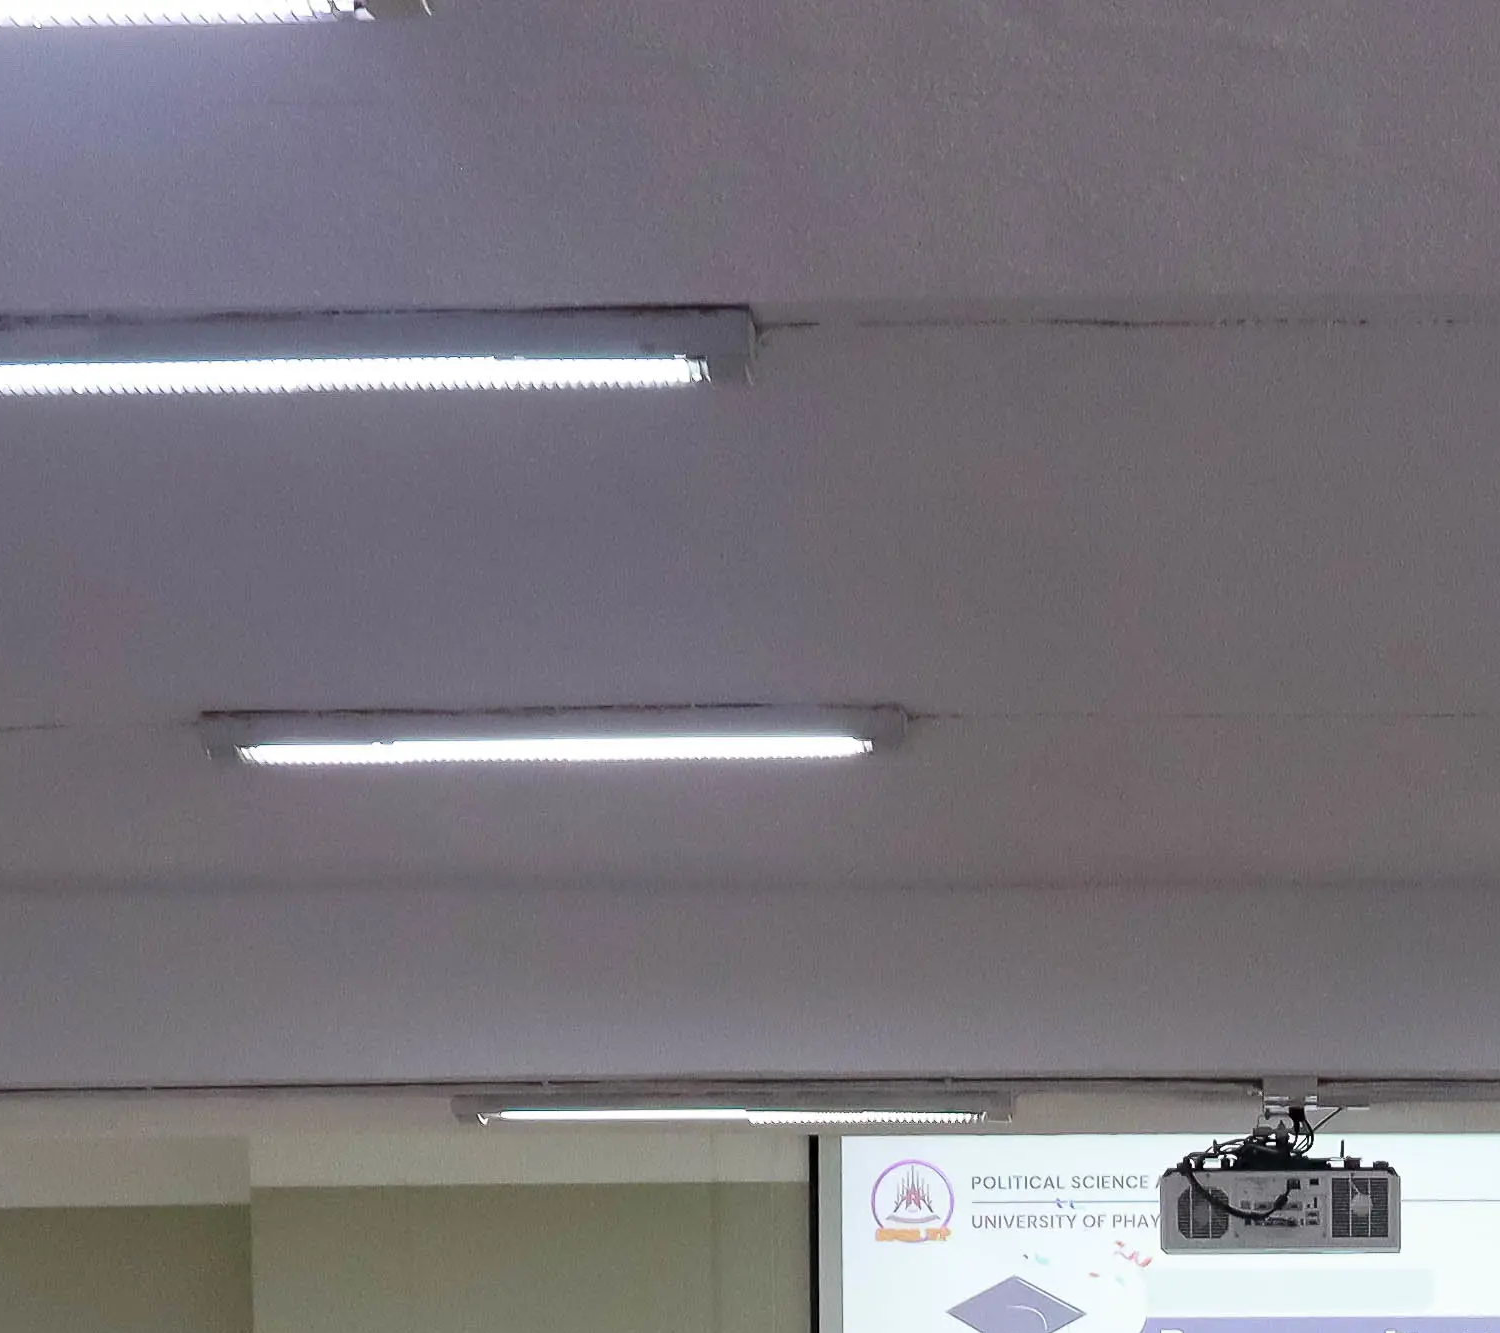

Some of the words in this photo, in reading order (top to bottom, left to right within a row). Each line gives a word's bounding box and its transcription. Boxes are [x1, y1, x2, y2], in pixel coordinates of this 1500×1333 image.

[972, 1175, 1065, 1190] POLITICAL
[1071, 1175, 1149, 1190] SCIENCE
[972, 1214, 1077, 1229] UNIVERSITY
[1083, 1214, 1104, 1229] OF
